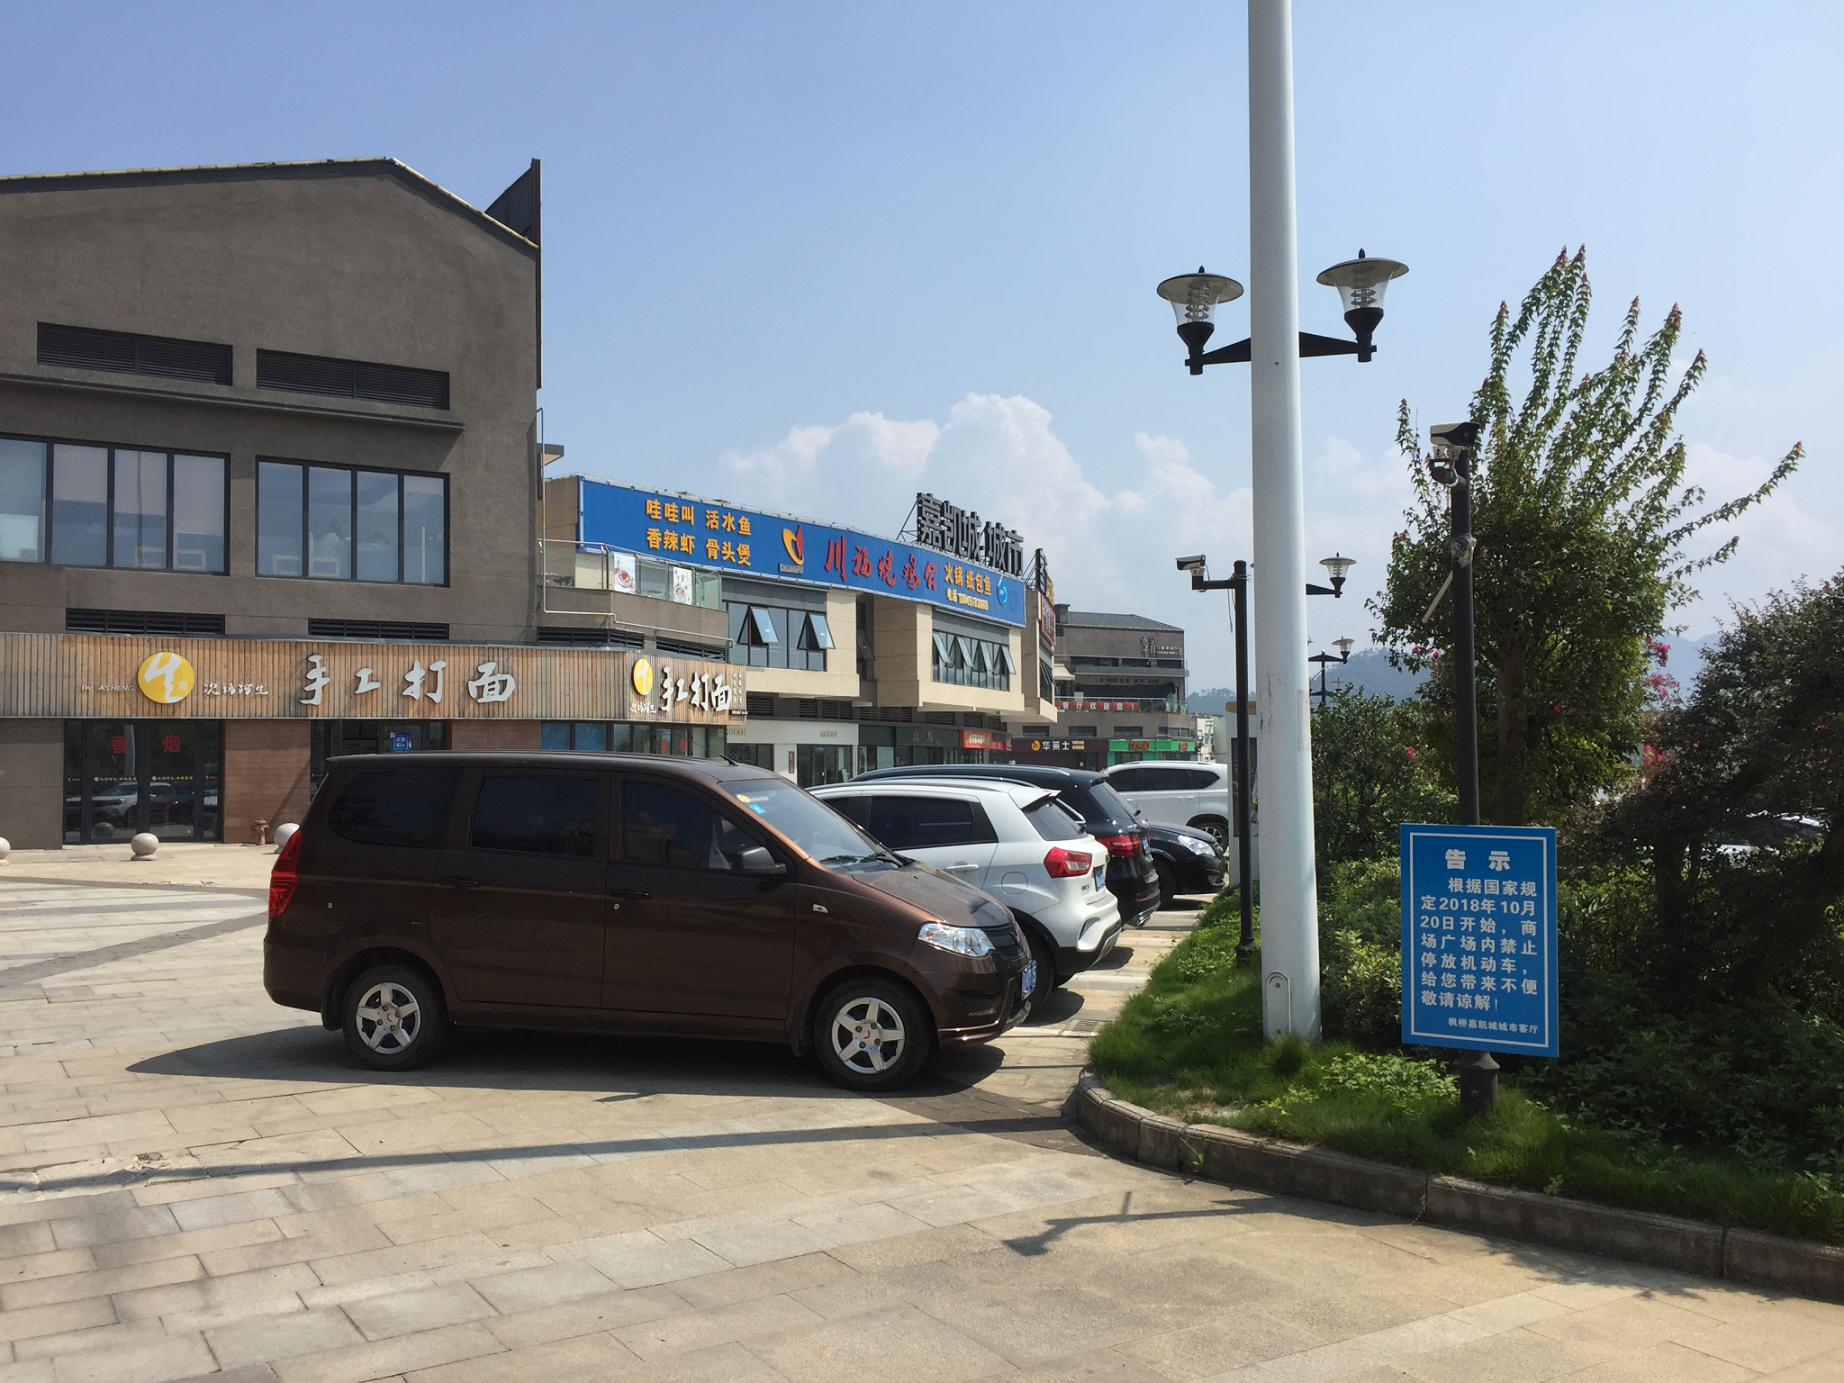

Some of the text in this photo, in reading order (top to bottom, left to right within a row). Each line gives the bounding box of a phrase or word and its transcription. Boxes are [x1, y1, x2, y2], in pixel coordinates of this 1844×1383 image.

[645, 499, 752, 536] 哇哇叫 活水鱼
[646, 527, 752, 567] 香辣虾 骨头煲
[300, 654, 516, 705] 手工打面
[660, 666, 733, 712] 手工打面
[1445, 849, 1511, 872] 告示
[1448, 877, 1537, 897] 根据国家规
[1421, 933, 1538, 956] 场广场内禁止
[1421, 952, 1527, 975] 停放机动车，
[1421, 971, 1538, 995] 给您带来不便
